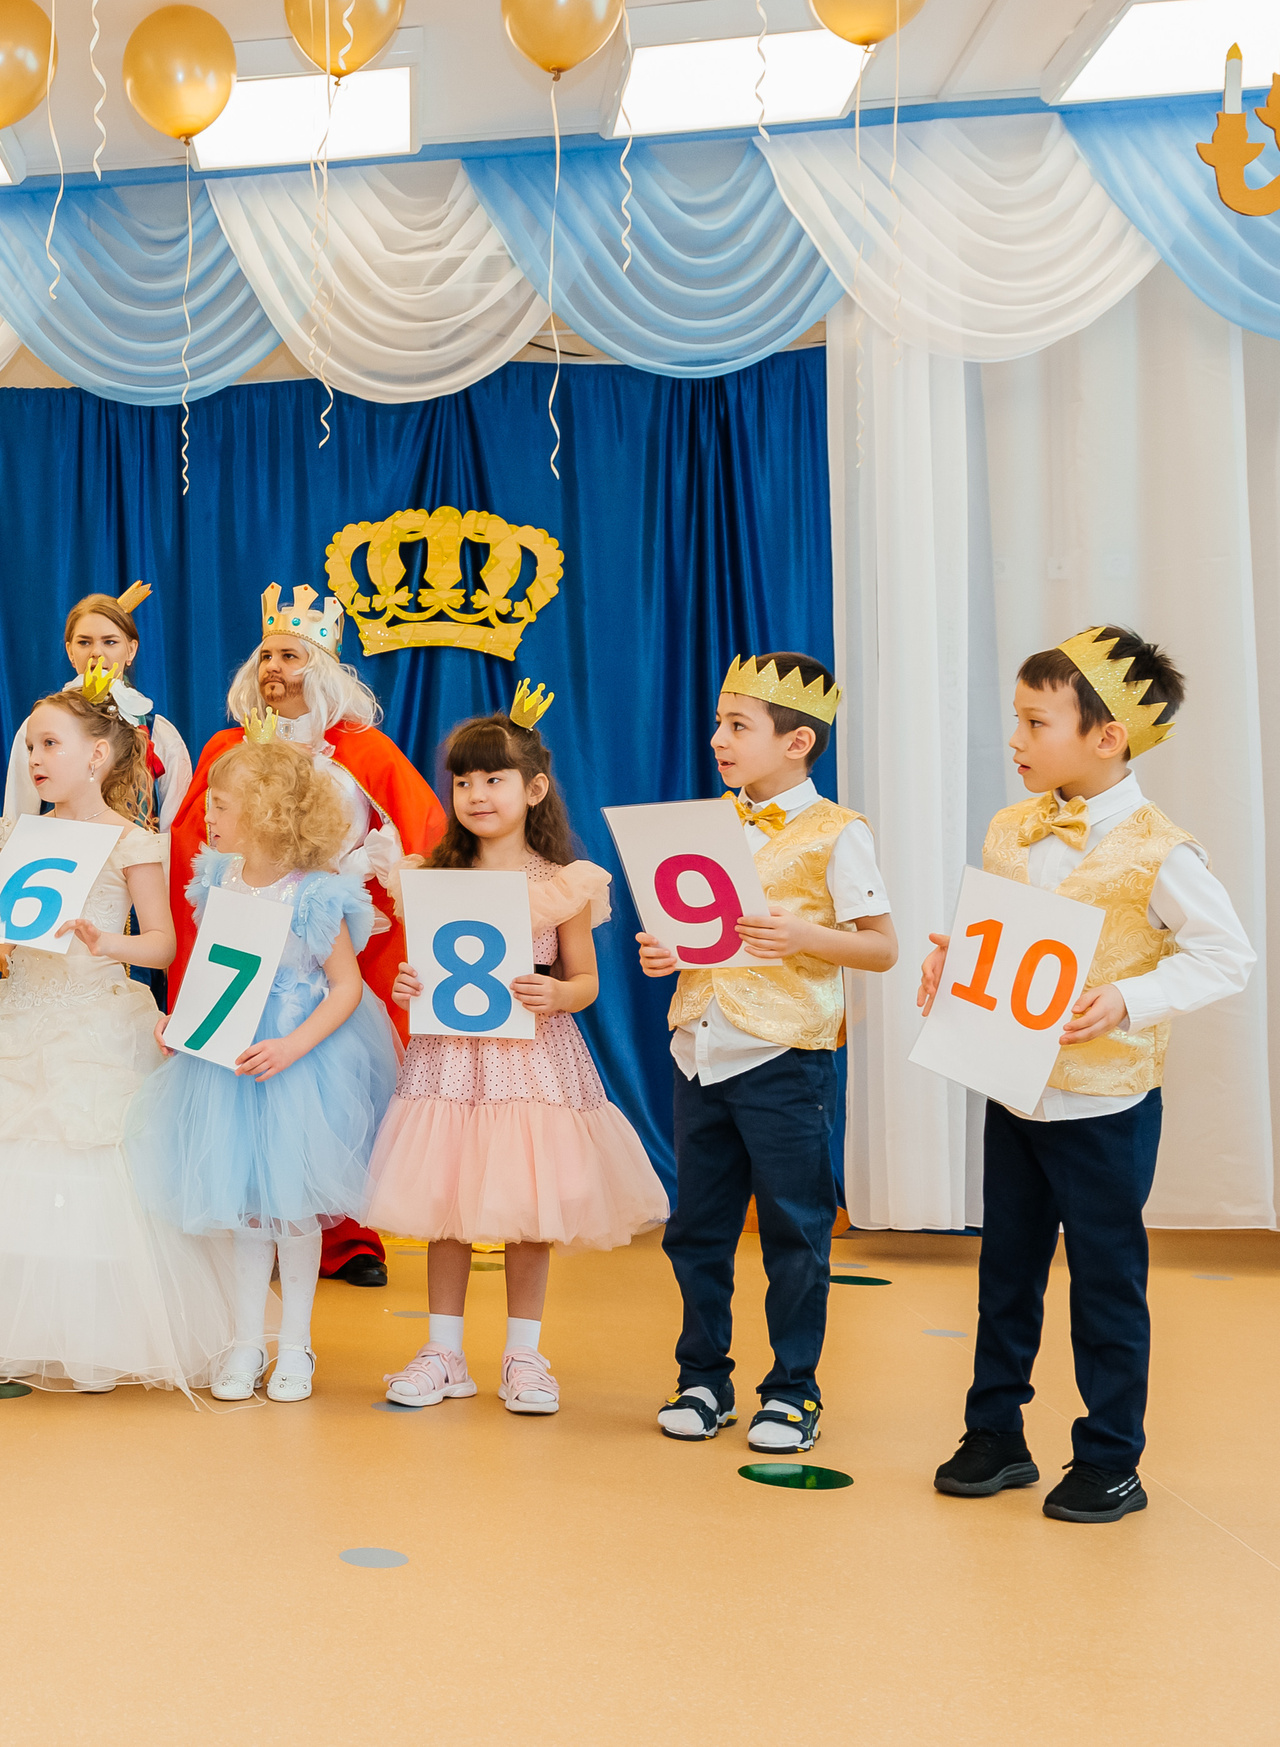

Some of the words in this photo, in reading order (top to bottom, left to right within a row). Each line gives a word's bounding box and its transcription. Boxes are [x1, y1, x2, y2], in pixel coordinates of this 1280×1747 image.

[654, 853, 743, 964] 9
[184, 943, 262, 1050] 7
[432, 920, 512, 1032] 8
[950, 918, 1078, 1030] 10
